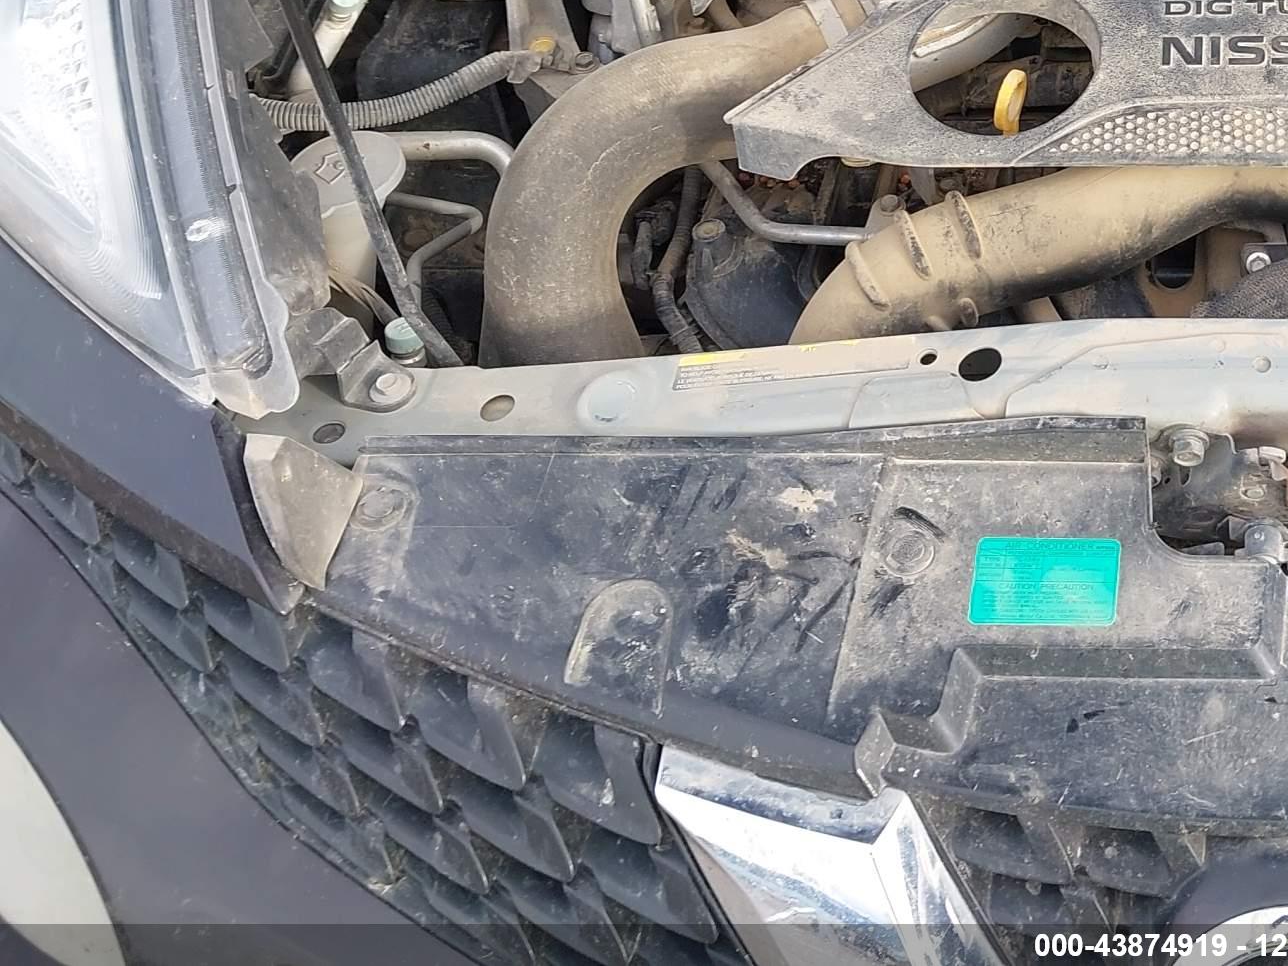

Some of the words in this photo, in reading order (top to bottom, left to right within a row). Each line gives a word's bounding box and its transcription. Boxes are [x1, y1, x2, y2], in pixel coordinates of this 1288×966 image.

[1164, 0, 1232, 15] DIG
[1028, 542, 1094, 550] CONDITIONER
[999, 583, 1036, 591] CAUTION
[1040, 583, 1095, 591] PRECAUTION
